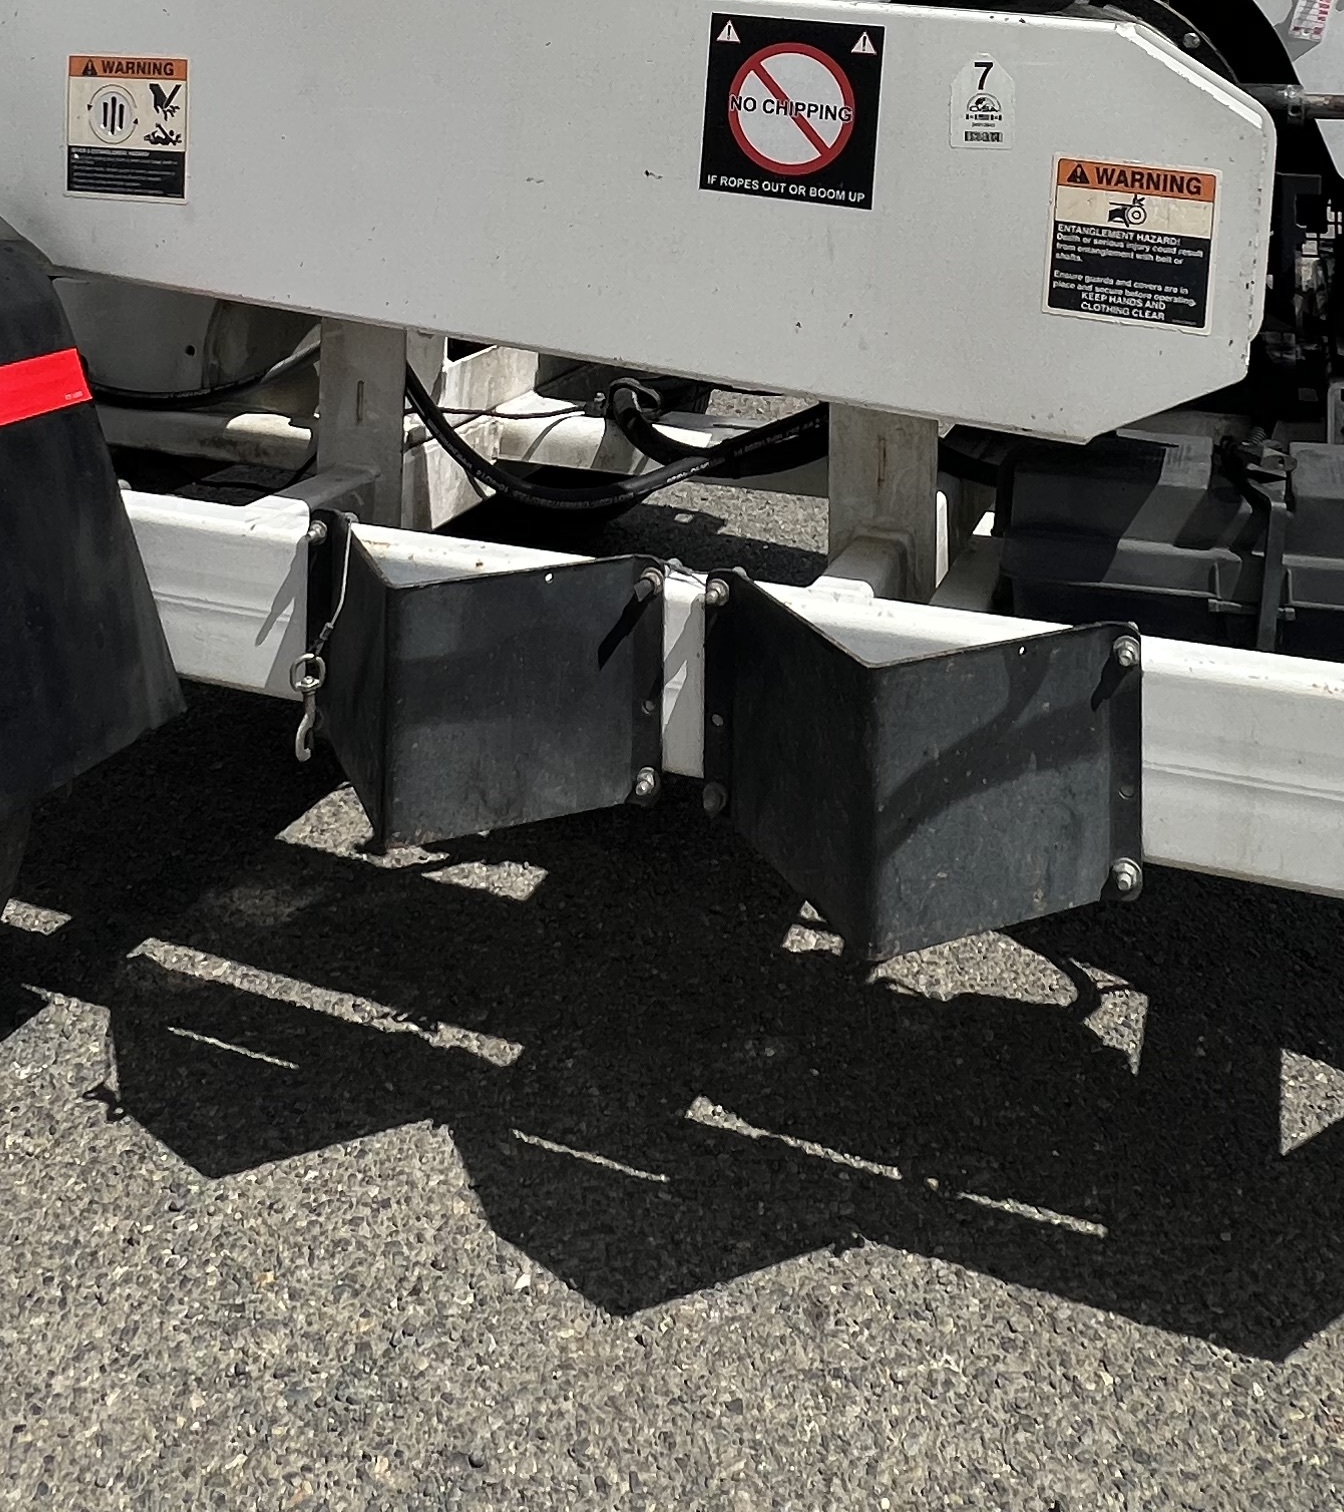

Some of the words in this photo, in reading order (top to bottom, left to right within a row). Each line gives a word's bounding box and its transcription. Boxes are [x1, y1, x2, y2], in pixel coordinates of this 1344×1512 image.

[101, 60, 175, 76] WARNING
[974, 61, 994, 90] 7
[730, 95, 757, 112] NO
[762, 98, 853, 122] CHIPPING
[707, 174, 717, 185] IF
[720, 175, 759, 190] ROPES
[762, 180, 786, 194] OUT
[788, 184, 806, 196] OR
[809, 186, 846, 201] BOOM
[848, 191, 865, 203] UP
[1094, 166, 1202, 196] WARNING
[1058, 223, 1134, 241] ENTANGLEMENT
[1056, 232, 1081, 243] Death
[1082, 236, 1091, 244] or
[1093, 238, 1124, 249] serious
[1126, 241, 1150, 253] injury
[1152, 244, 1176, 254] could
[1178, 248, 1204, 258] result
[1056, 242, 1075, 251] from
[1078, 245, 1134, 260] entanglement
[1136, 252, 1153, 261] with
[1156, 254, 1172, 263] belt
[1053, 280, 1075, 290] place
[1077, 282, 1093, 292] and
[1095, 286, 1123, 296] secure
[1125, 289, 1152, 300] before
[1054, 269, 1083, 281] Ensure
[1085, 275, 1113, 286] guards
[1116, 277, 1132, 287] and
[1133, 281, 1162, 292] covers
[1164, 285, 1178, 293] are
[1179, 286, 1189, 295] in
[1081, 291, 1108, 302] KEEP
[1109, 295, 1143, 307] HANDS
[1145, 299, 1166, 310] AND
[1081, 301, 1129, 316] CLOTHING
[1131, 309, 1165, 320] CLEAR
